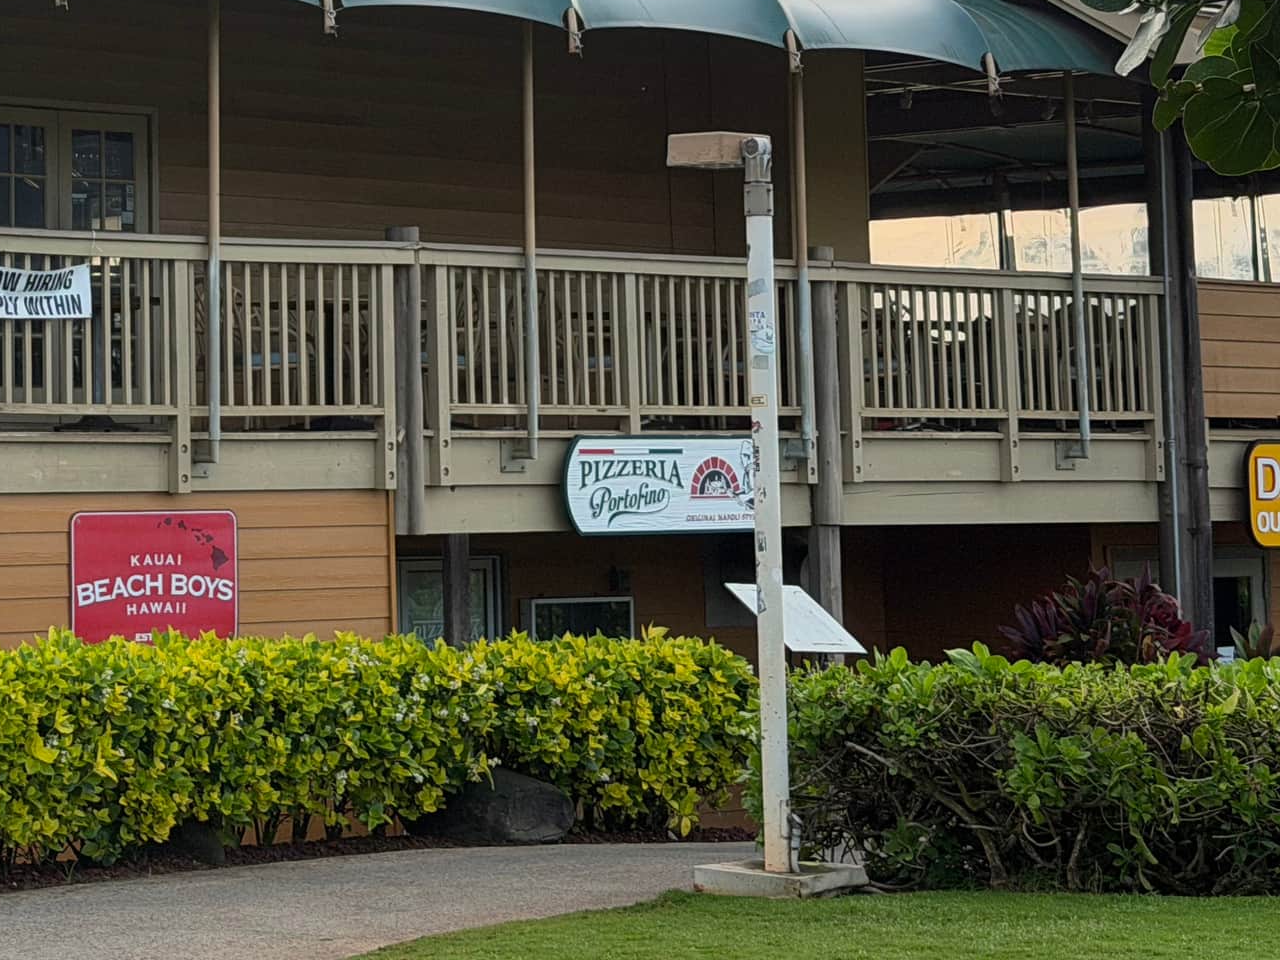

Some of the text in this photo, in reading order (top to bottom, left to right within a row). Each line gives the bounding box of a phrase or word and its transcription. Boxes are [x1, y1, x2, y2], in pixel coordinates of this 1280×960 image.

[23, 270, 74, 292] HIRING
[24, 294, 83, 316] WITHIN
[579, 459, 684, 489] PIZZERIA
[589, 482, 668, 520] Portofino
[130, 553, 182, 567] KAUAI
[76, 573, 234, 607] BEACH BOYS
[126, 602, 187, 616] HAWAII
